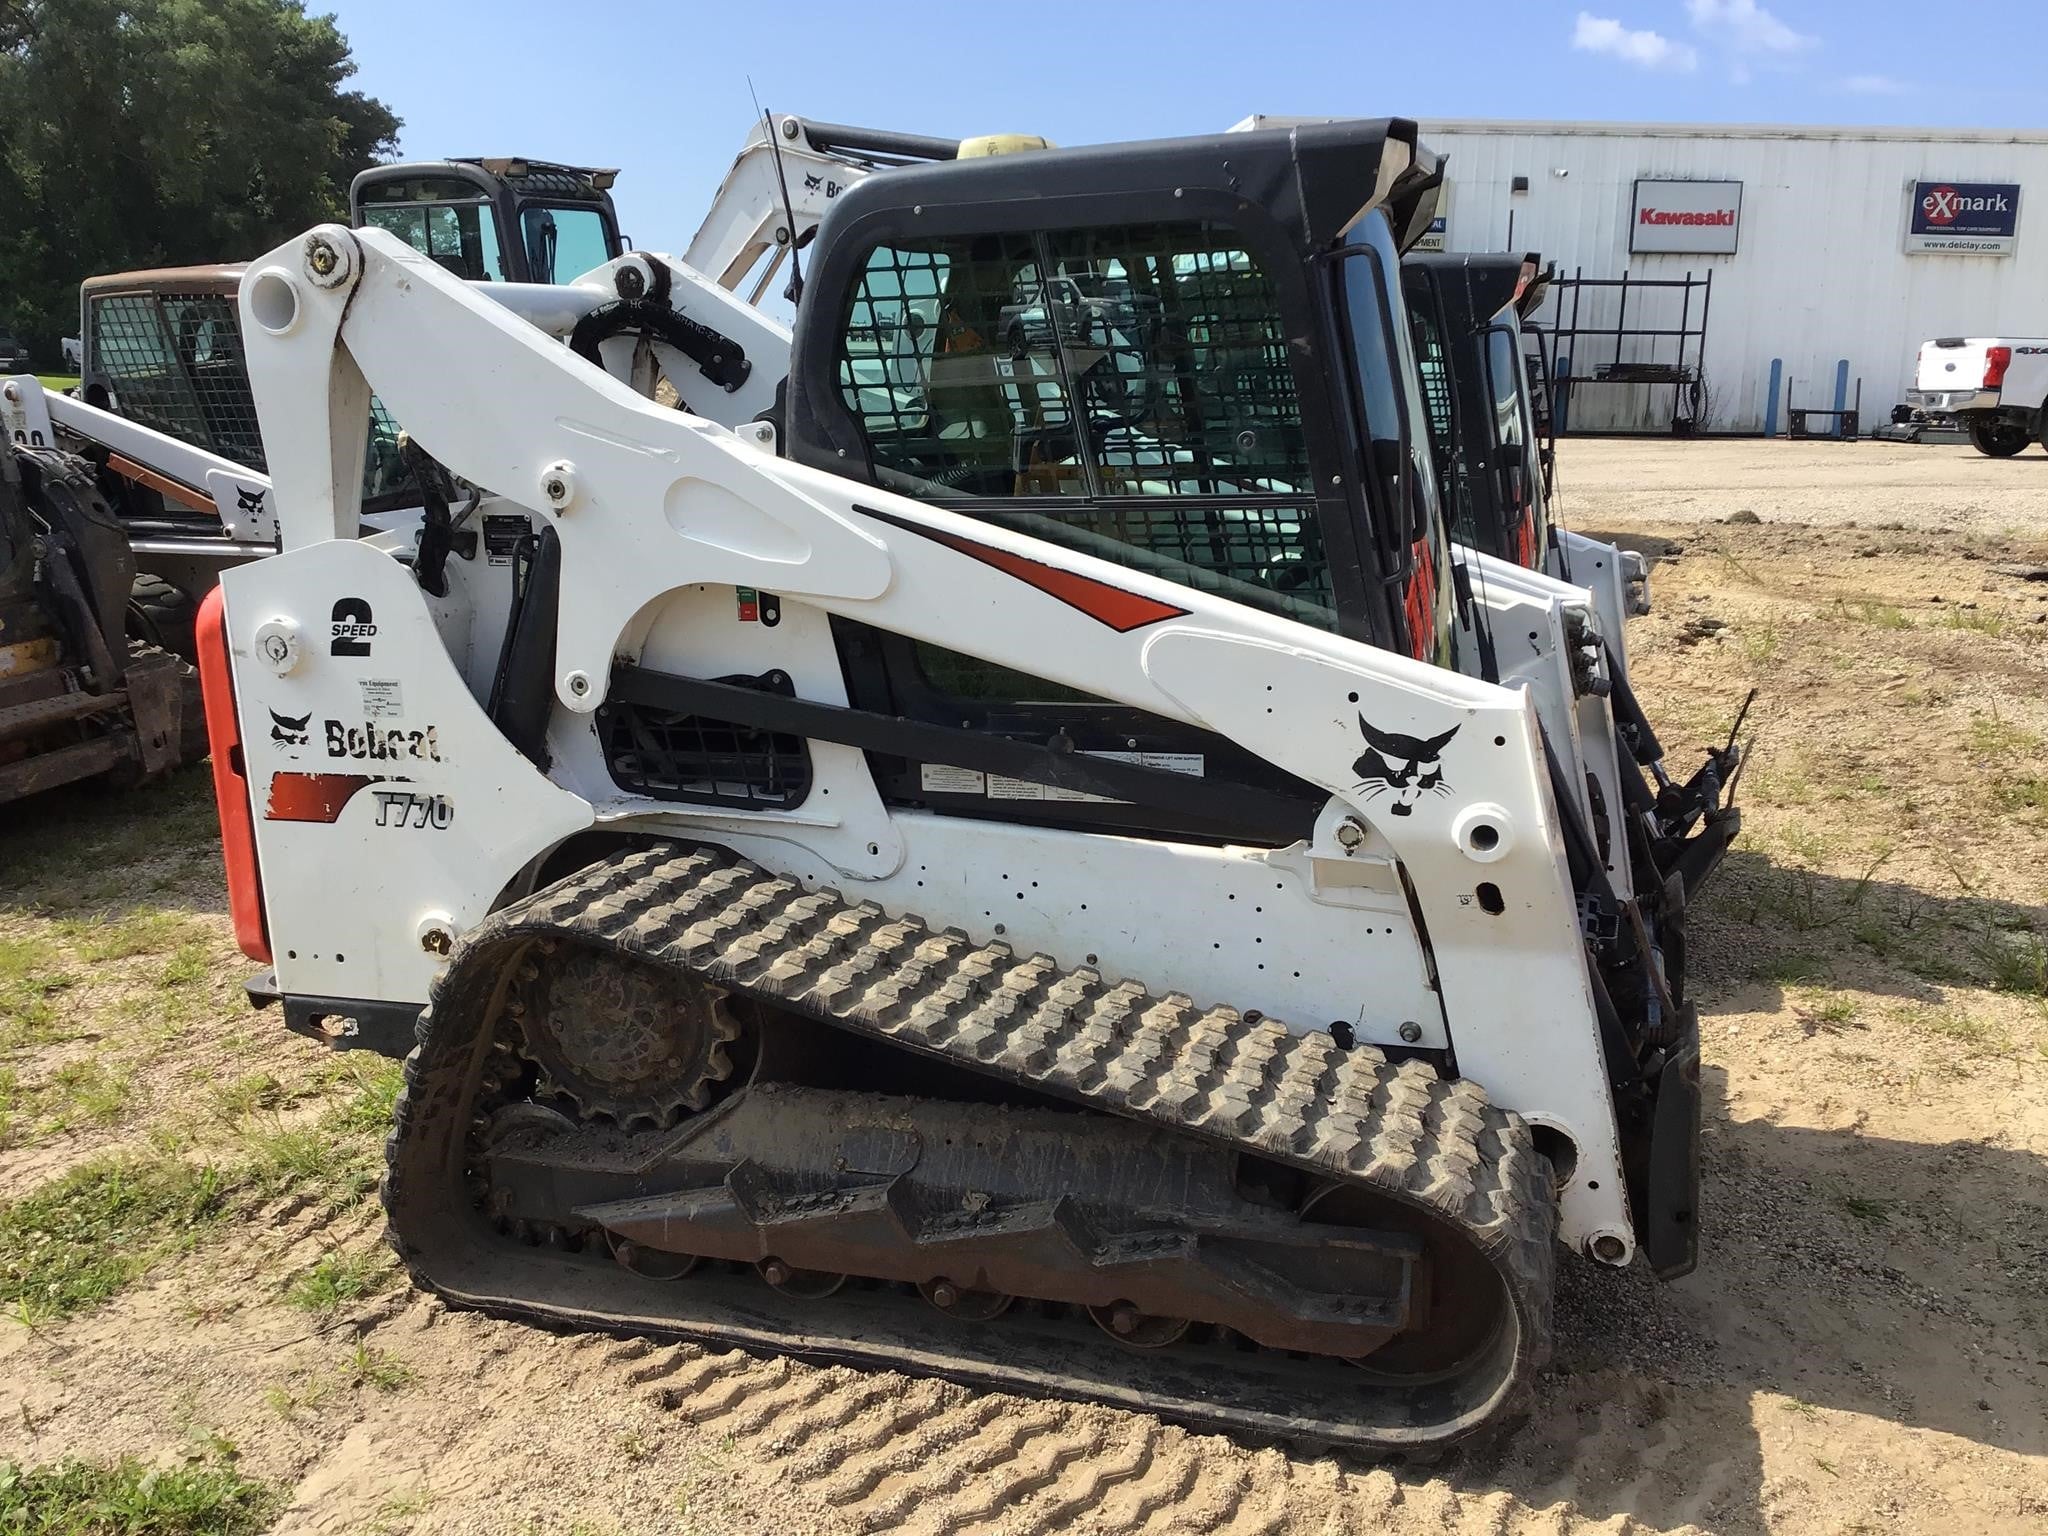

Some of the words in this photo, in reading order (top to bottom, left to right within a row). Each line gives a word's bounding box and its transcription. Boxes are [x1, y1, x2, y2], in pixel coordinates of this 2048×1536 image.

[1640, 208, 1735, 226] Kawasaki
[1924, 241, 2001, 251] www.delclay.com
[331, 597, 372, 657] 2
[331, 624, 378, 637] SPEED
[324, 720, 441, 763] Bobcat
[372, 791, 454, 830] T770
